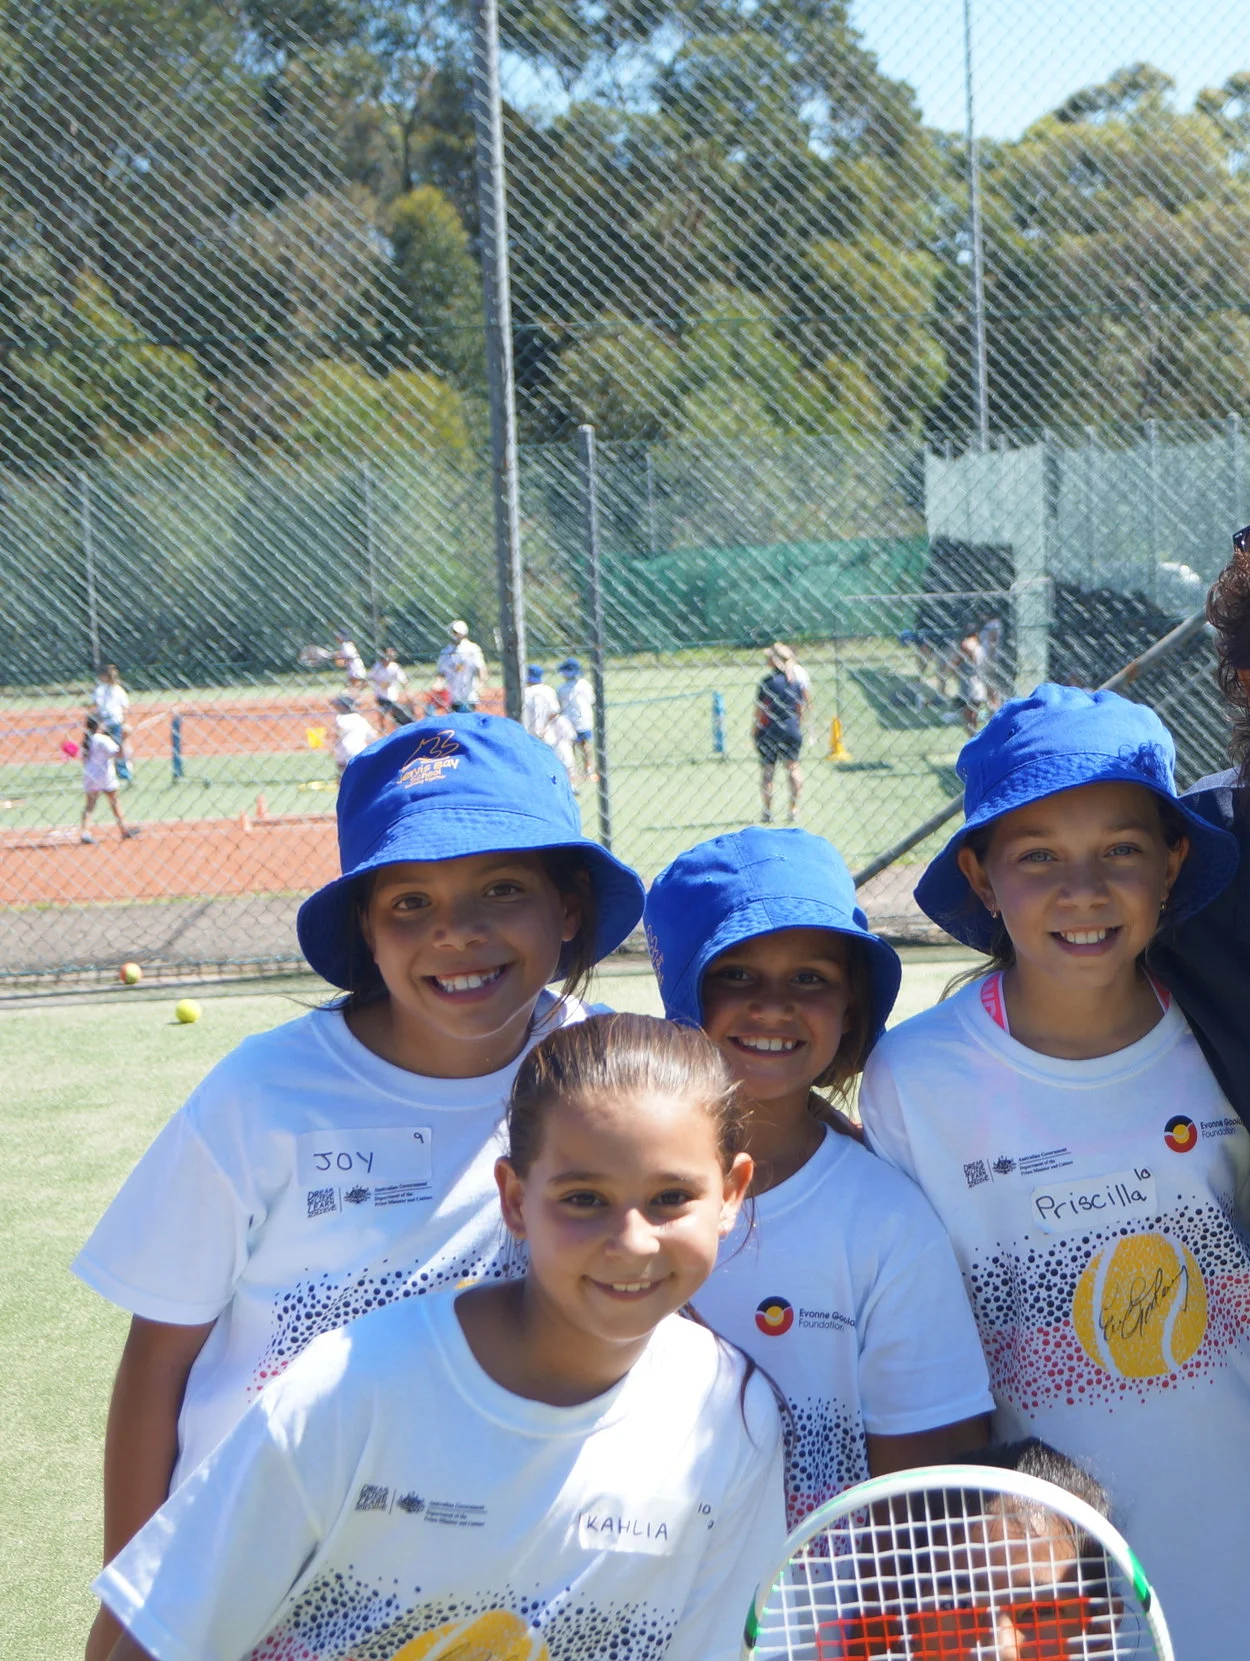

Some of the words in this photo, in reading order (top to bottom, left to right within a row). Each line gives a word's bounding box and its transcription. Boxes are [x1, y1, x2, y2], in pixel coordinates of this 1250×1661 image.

[413, 1132, 424, 1144] 9
[313, 1151, 374, 1174] JOY
[1035, 1183, 1148, 1221] Priscilla
[799, 1308, 830, 1320] Evonne
[798, 1319, 845, 1332] Foundation
[586, 1514, 669, 1541] KAHLIA
